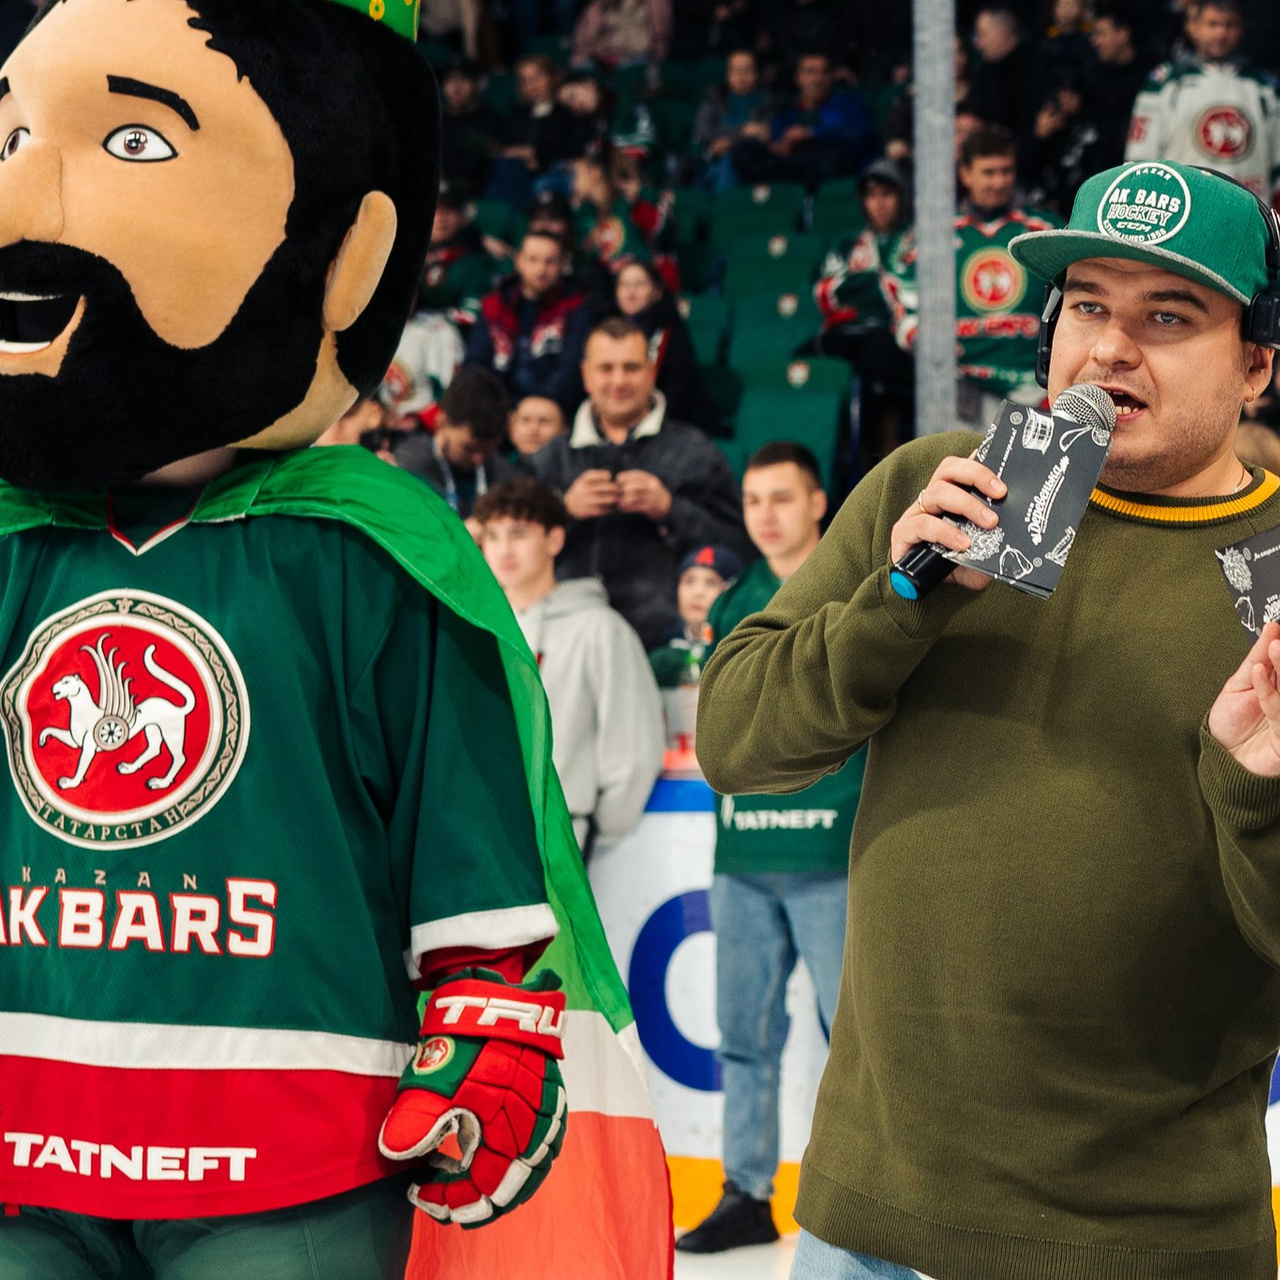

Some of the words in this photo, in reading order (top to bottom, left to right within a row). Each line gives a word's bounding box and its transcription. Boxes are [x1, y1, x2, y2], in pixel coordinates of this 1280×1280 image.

[1136, 167, 1172, 181] KAZAN
[1108, 188, 1131, 204] AK
[1134, 189, 1181, 213] BARS
[1106, 204, 1173, 227] HOCKEY
[1116, 221, 1152, 233] CCM
[1103, 219, 1145, 242] ESTABLISHED
[1027, 463, 1064, 535] Деревенька
[42, 804, 182, 842] ТАТАРСТАН
[733, 809, 839, 831] TATNEFT
[22, 866, 198, 891] KAZAN
[58, 876, 279, 959] BARS
[4, 1131, 257, 1182] TATNEFT
